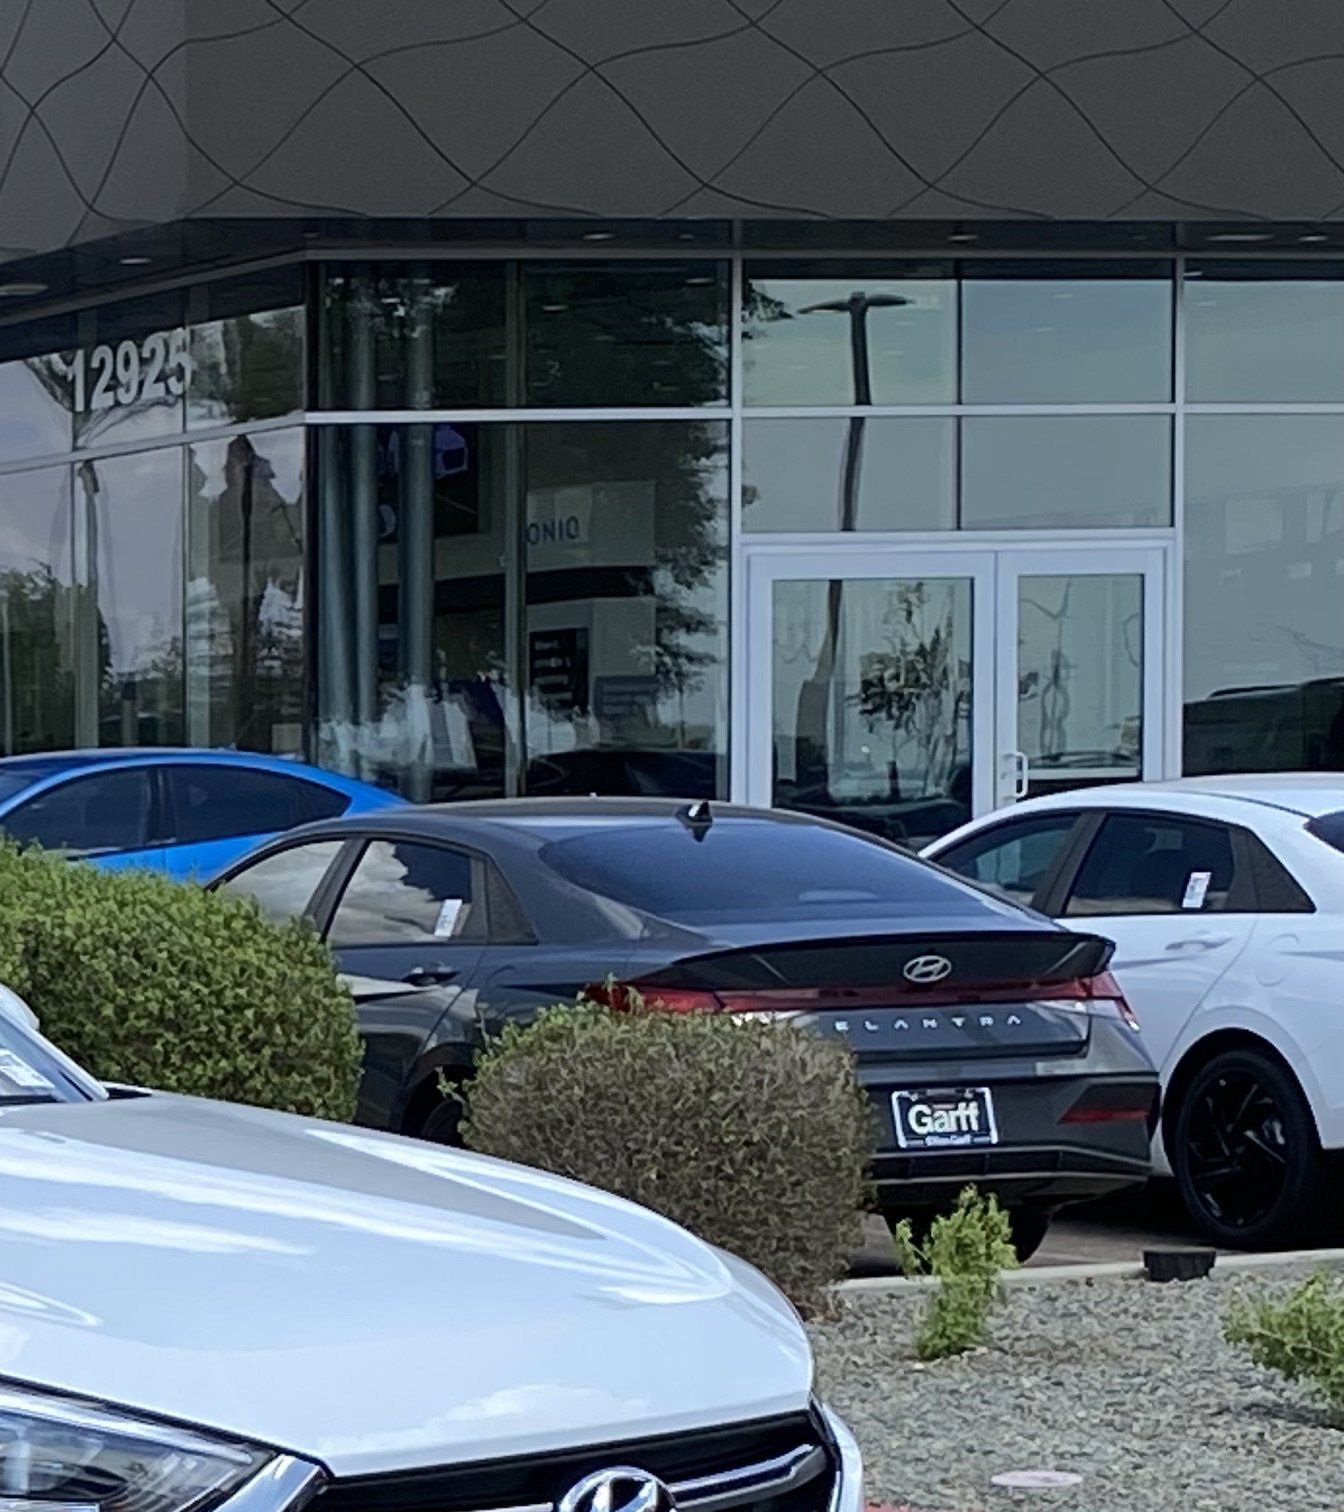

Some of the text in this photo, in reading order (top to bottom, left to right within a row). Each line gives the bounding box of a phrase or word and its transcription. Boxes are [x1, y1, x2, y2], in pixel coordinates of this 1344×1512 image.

[68, 327, 193, 413] 12925
[524, 515, 579, 545] ONIQ
[834, 1014, 1022, 1032] ELANTRA
[907, 1101, 980, 1135] Garff
